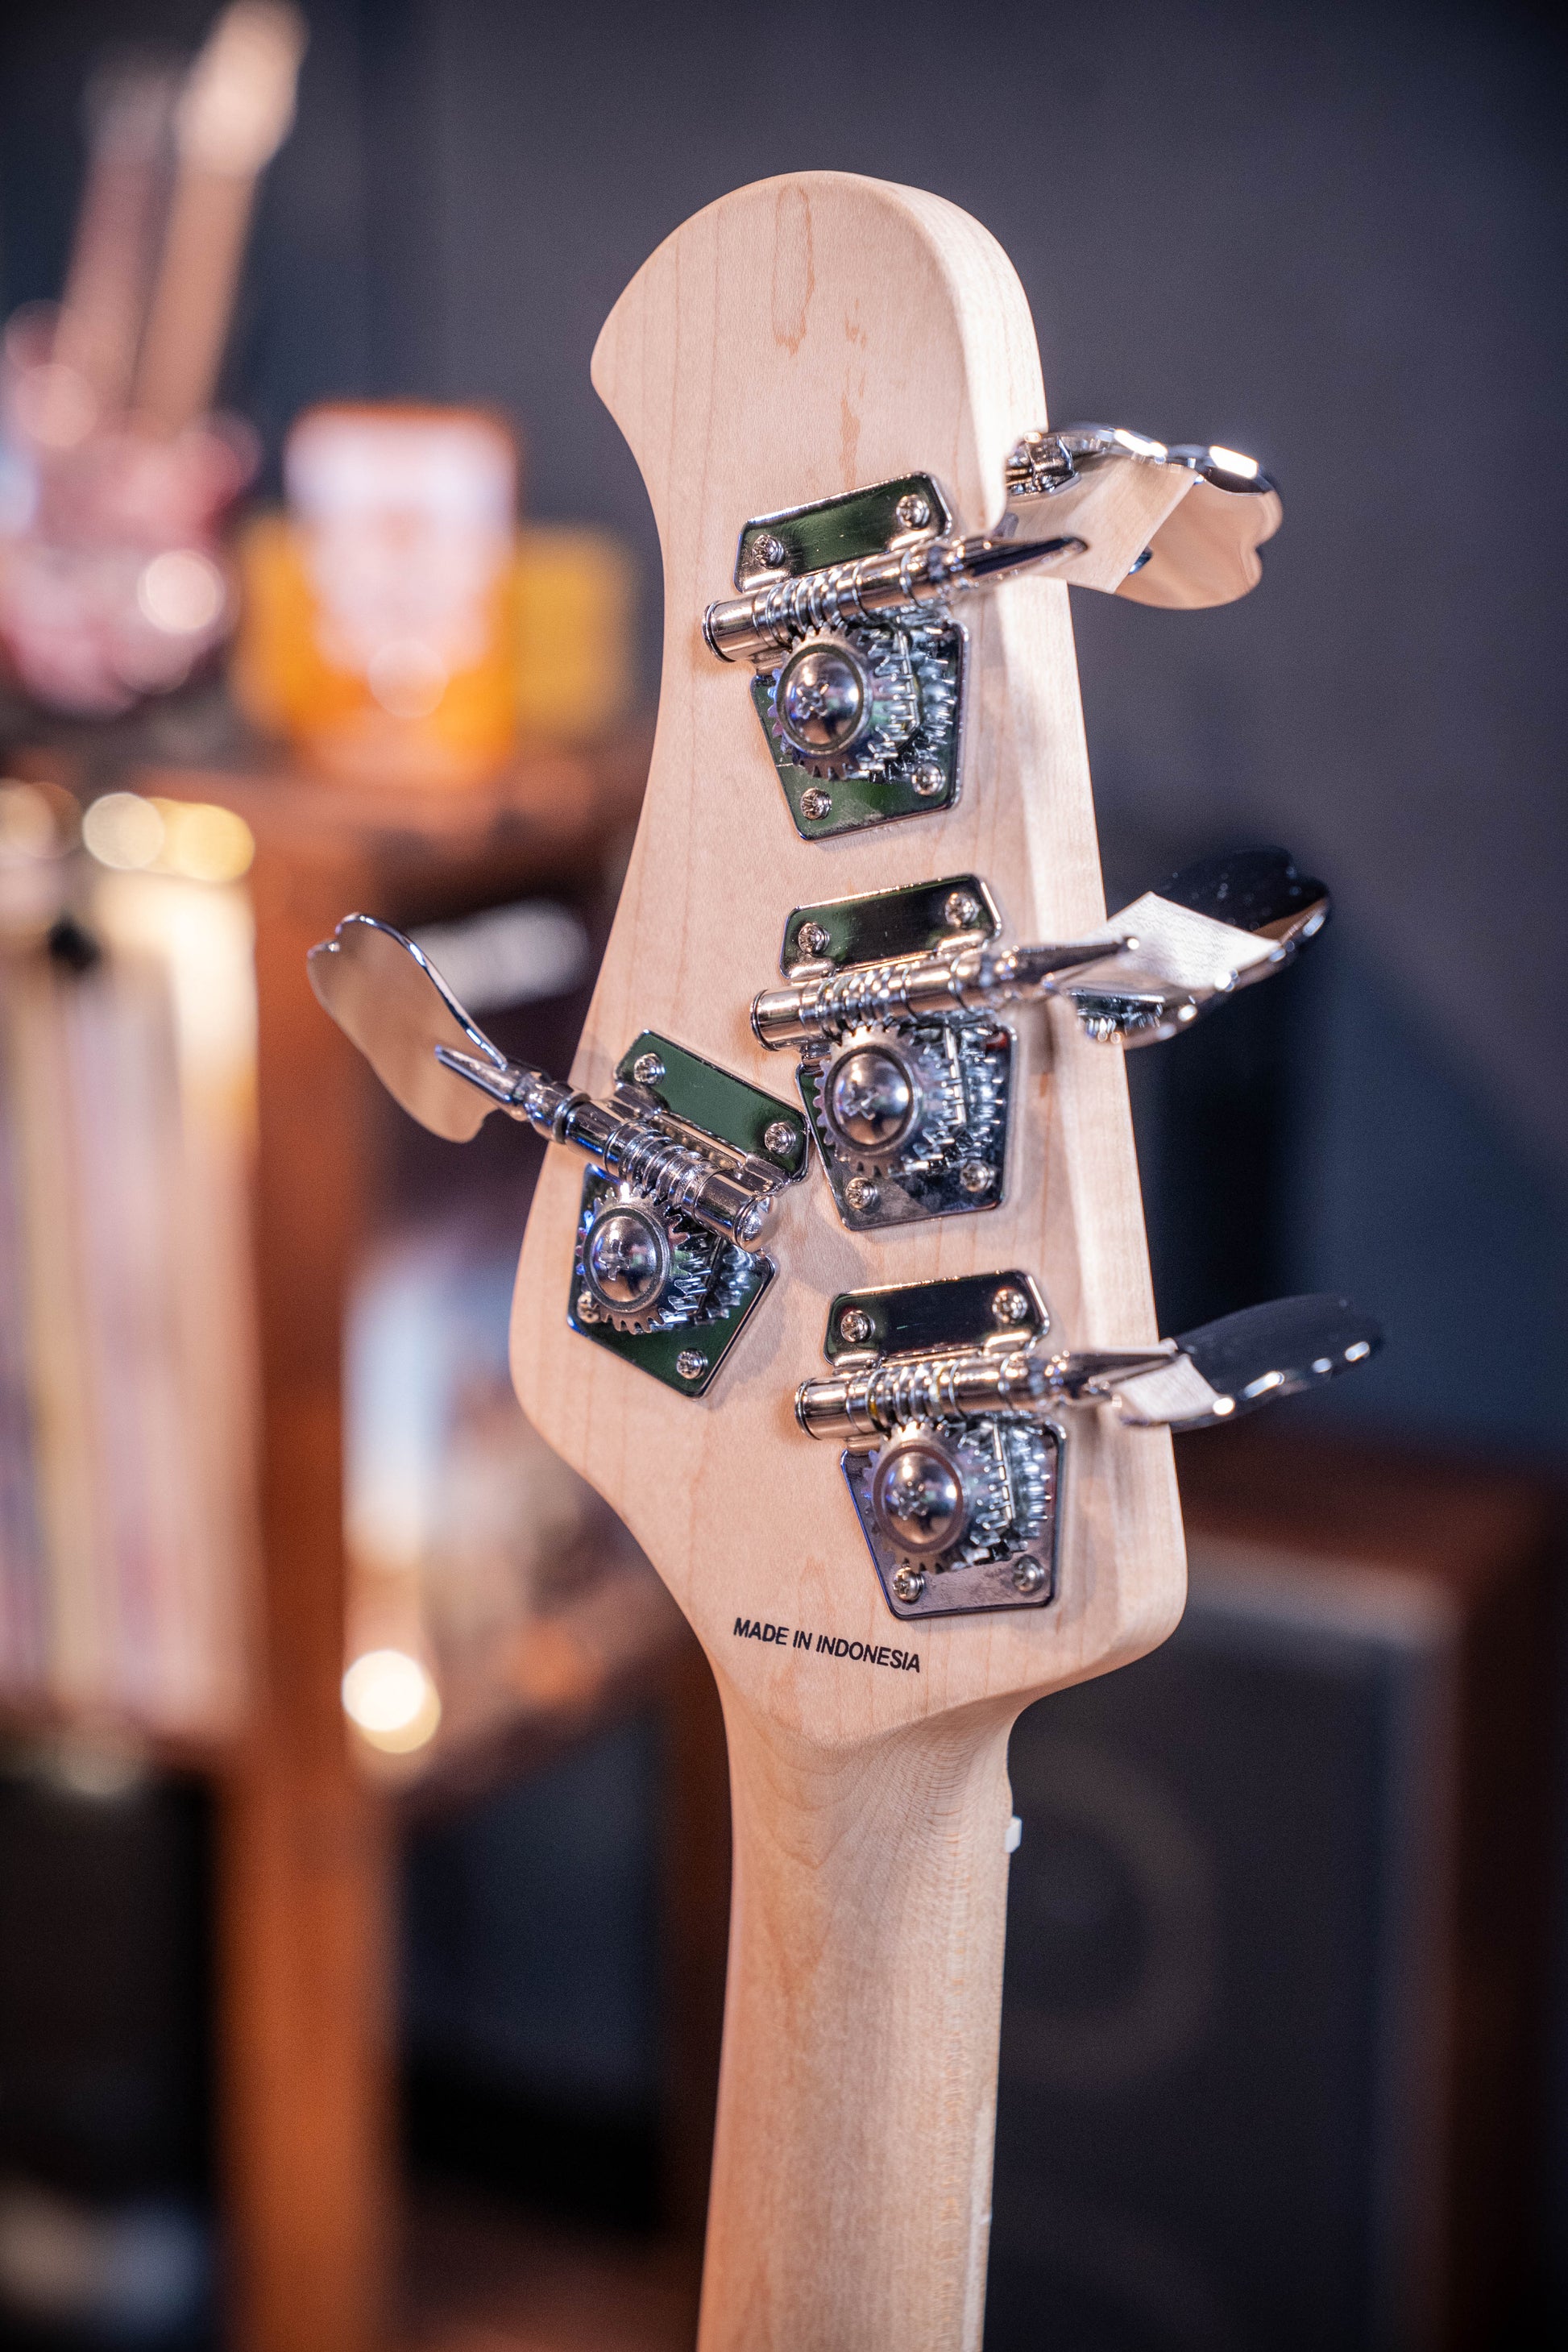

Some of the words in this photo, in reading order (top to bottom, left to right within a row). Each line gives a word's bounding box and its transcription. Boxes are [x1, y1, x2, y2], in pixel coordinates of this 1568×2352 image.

[733, 1617, 790, 1645] MADE
[792, 1630, 813, 1650] IN
[815, 1634, 920, 1674] INDONESIA
